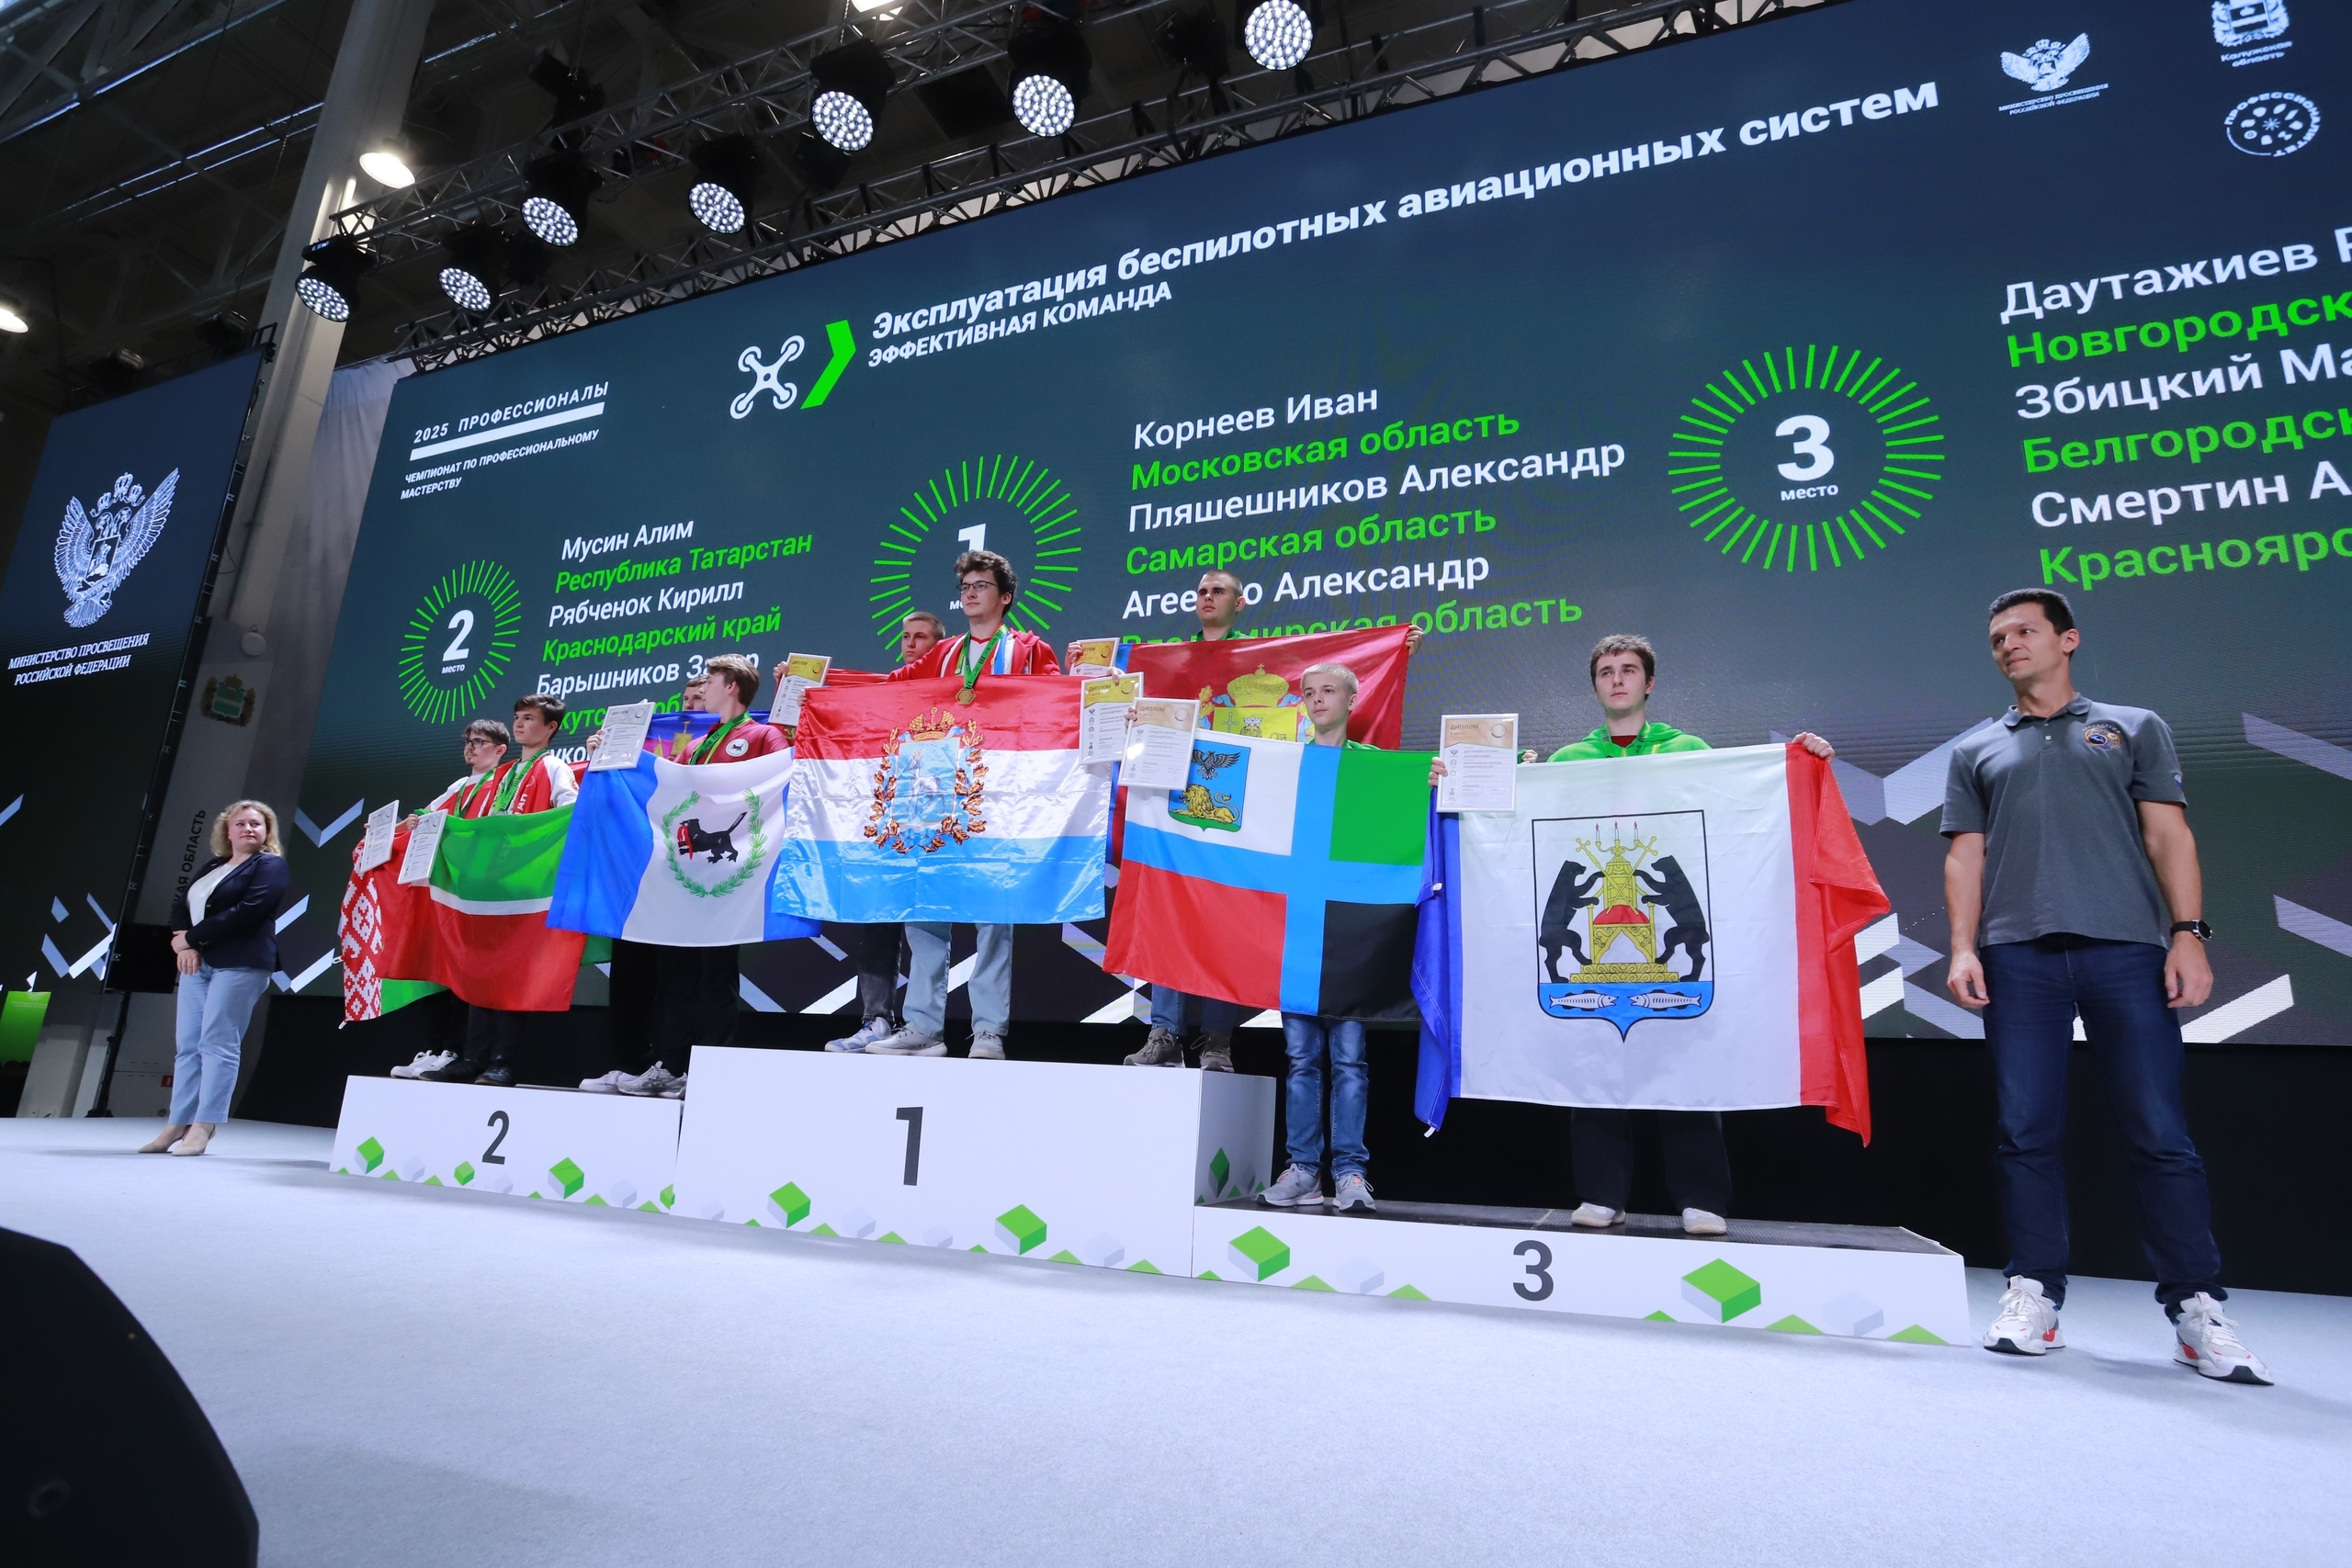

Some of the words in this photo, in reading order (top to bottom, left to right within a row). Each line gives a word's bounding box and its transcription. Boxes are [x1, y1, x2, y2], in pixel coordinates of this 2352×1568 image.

[2221, 40, 2293, 62] Калужская
[2232, 51, 2286, 67] область
[872, 264, 1107, 339] Эксплуатация
[1117, 199, 1387, 280] беспилотных
[1397, 127, 1727, 219] авиационных
[1739, 81, 1939, 146] систем
[2000, 243, 2318, 325] Даутажиев
[867, 310, 1037, 367] ЭФФЕКТИВНАЯ
[1042, 281, 1172, 328] КОМАНДА
[413, 423, 449, 444] 2025
[458, 381, 609, 433] ПРОФЕССИОНАЛЫ
[2015, 352, 2263, 419] Збицкий
[1134, 407, 1275, 450] Корнеев
[1287, 389, 1377, 424] Иван
[1775, 414, 1835, 482] 3
[405, 461, 463, 483] ЧЕМПИОНАТ
[462, 457, 477, 470] ПО
[479, 429, 600, 467] ПРОФЕССИОНАЛЬНОМУ
[1131, 436, 1348, 491] Московская
[1359, 412, 1521, 455] область
[400, 477, 462, 500] МАСТЕРСТВУ
[1129, 476, 1388, 533] Пляшешников
[1398, 444, 1625, 495] Александр
[1781, 484, 1839, 502] место
[2031, 474, 2290, 528] Смертин
[555, 557, 682, 593] Республика
[689, 534, 813, 571] Татарстан
[561, 532, 629, 563] Мусин
[632, 520, 695, 547] Алим
[1125, 529, 1323, 575] Самарская
[1335, 509, 1497, 548] область
[548, 595, 653, 628] Рябченок
[657, 581, 744, 614] Кирилл
[1122, 581, 1263, 620] Агеео
[1272, 557, 1489, 603] Александр
[1410, 598, 1583, 634] область
[7, 646, 78, 671] МИНИСТЕРСТВО
[78, 633, 151, 658] ПРОСВЕЩЕНИЯ
[442, 610, 474, 662] 2
[542, 615, 717, 666] Краснодарский
[721, 605, 782, 642] край
[14, 662, 74, 686] РОССИЙСКОЙ
[74, 654, 132, 676] ФЕДЕРАЦИИ
[441, 663, 466, 674] место
[536, 663, 680, 701] Барышников
[181, 809, 206, 873] ОБЛАСТЬ
[482, 1110, 510, 1166] 2
[895, 1106, 923, 1187] 1
[1512, 1240, 1555, 1302] 3
